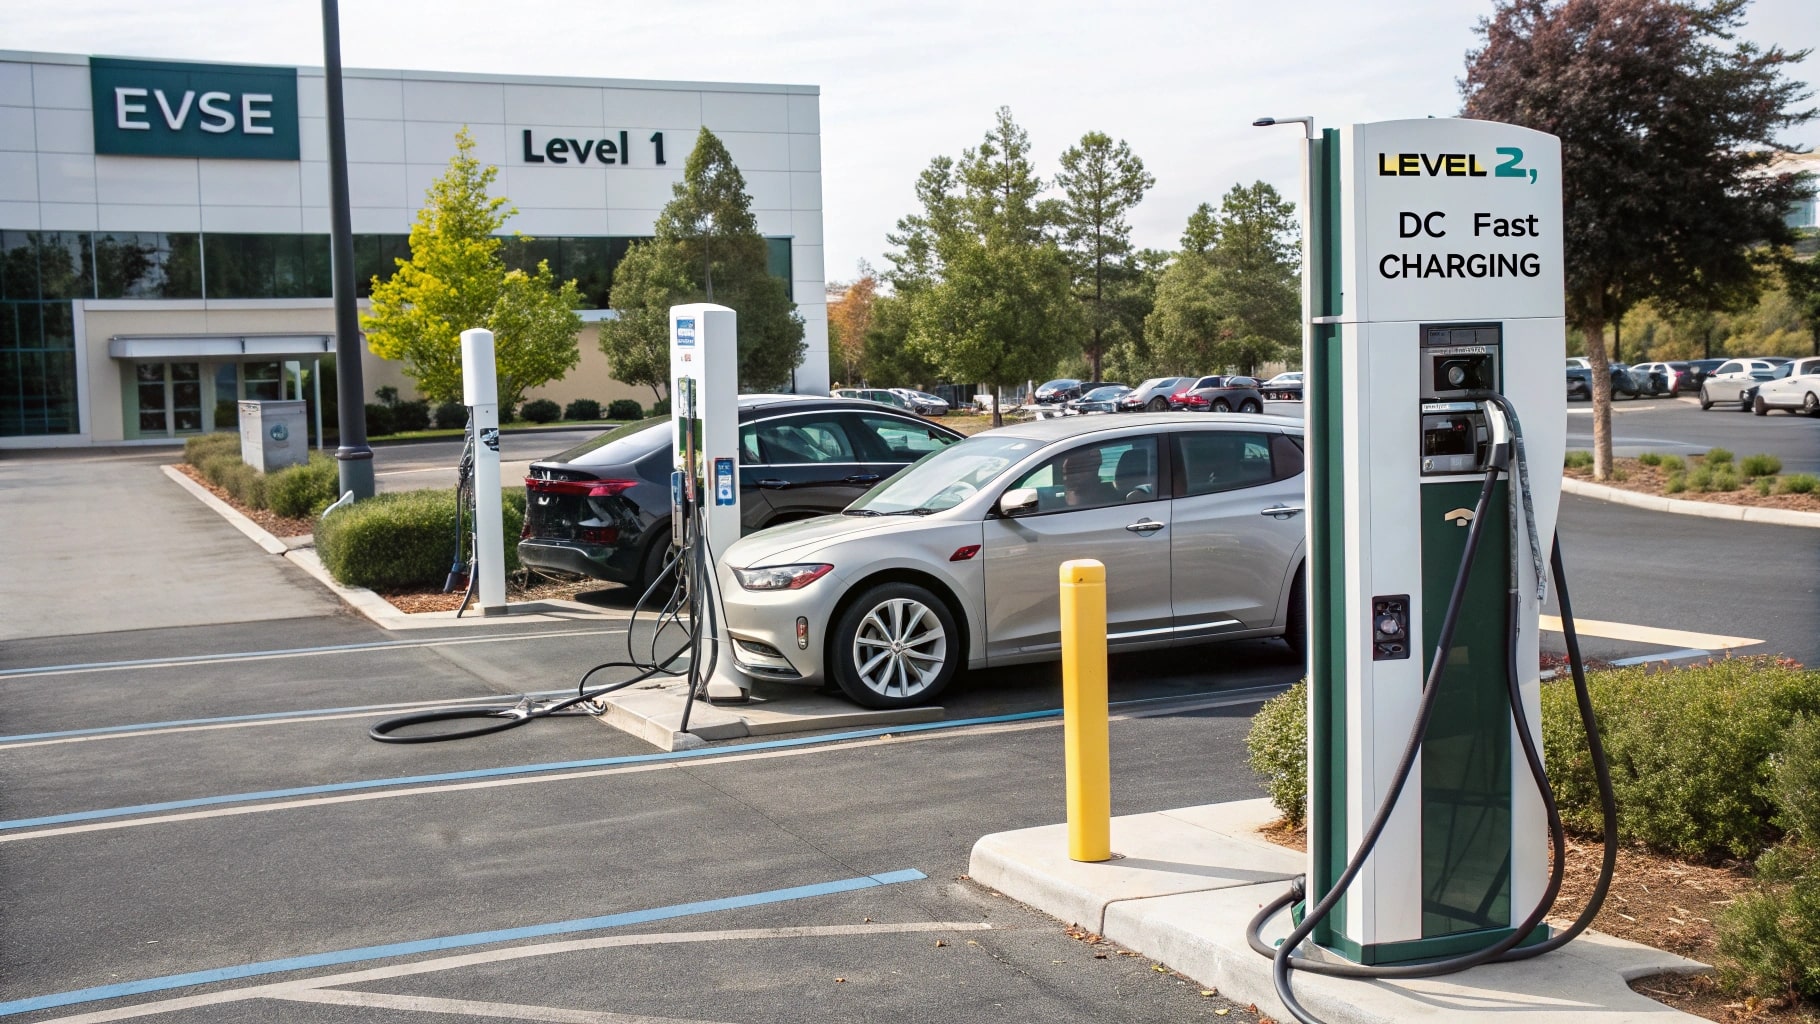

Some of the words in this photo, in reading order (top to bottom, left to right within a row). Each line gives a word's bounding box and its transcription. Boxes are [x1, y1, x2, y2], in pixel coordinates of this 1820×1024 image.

[114, 86, 275, 135] EVSE
[522, 129, 629, 165] Level
[649, 131, 667, 166] 1
[1378, 152, 1488, 178] LEVEL
[1494, 146, 1538, 185] 2,
[1399, 210, 1447, 239] DC
[1473, 212, 1540, 238] Fast
[1379, 252, 1541, 280] CHARGING
